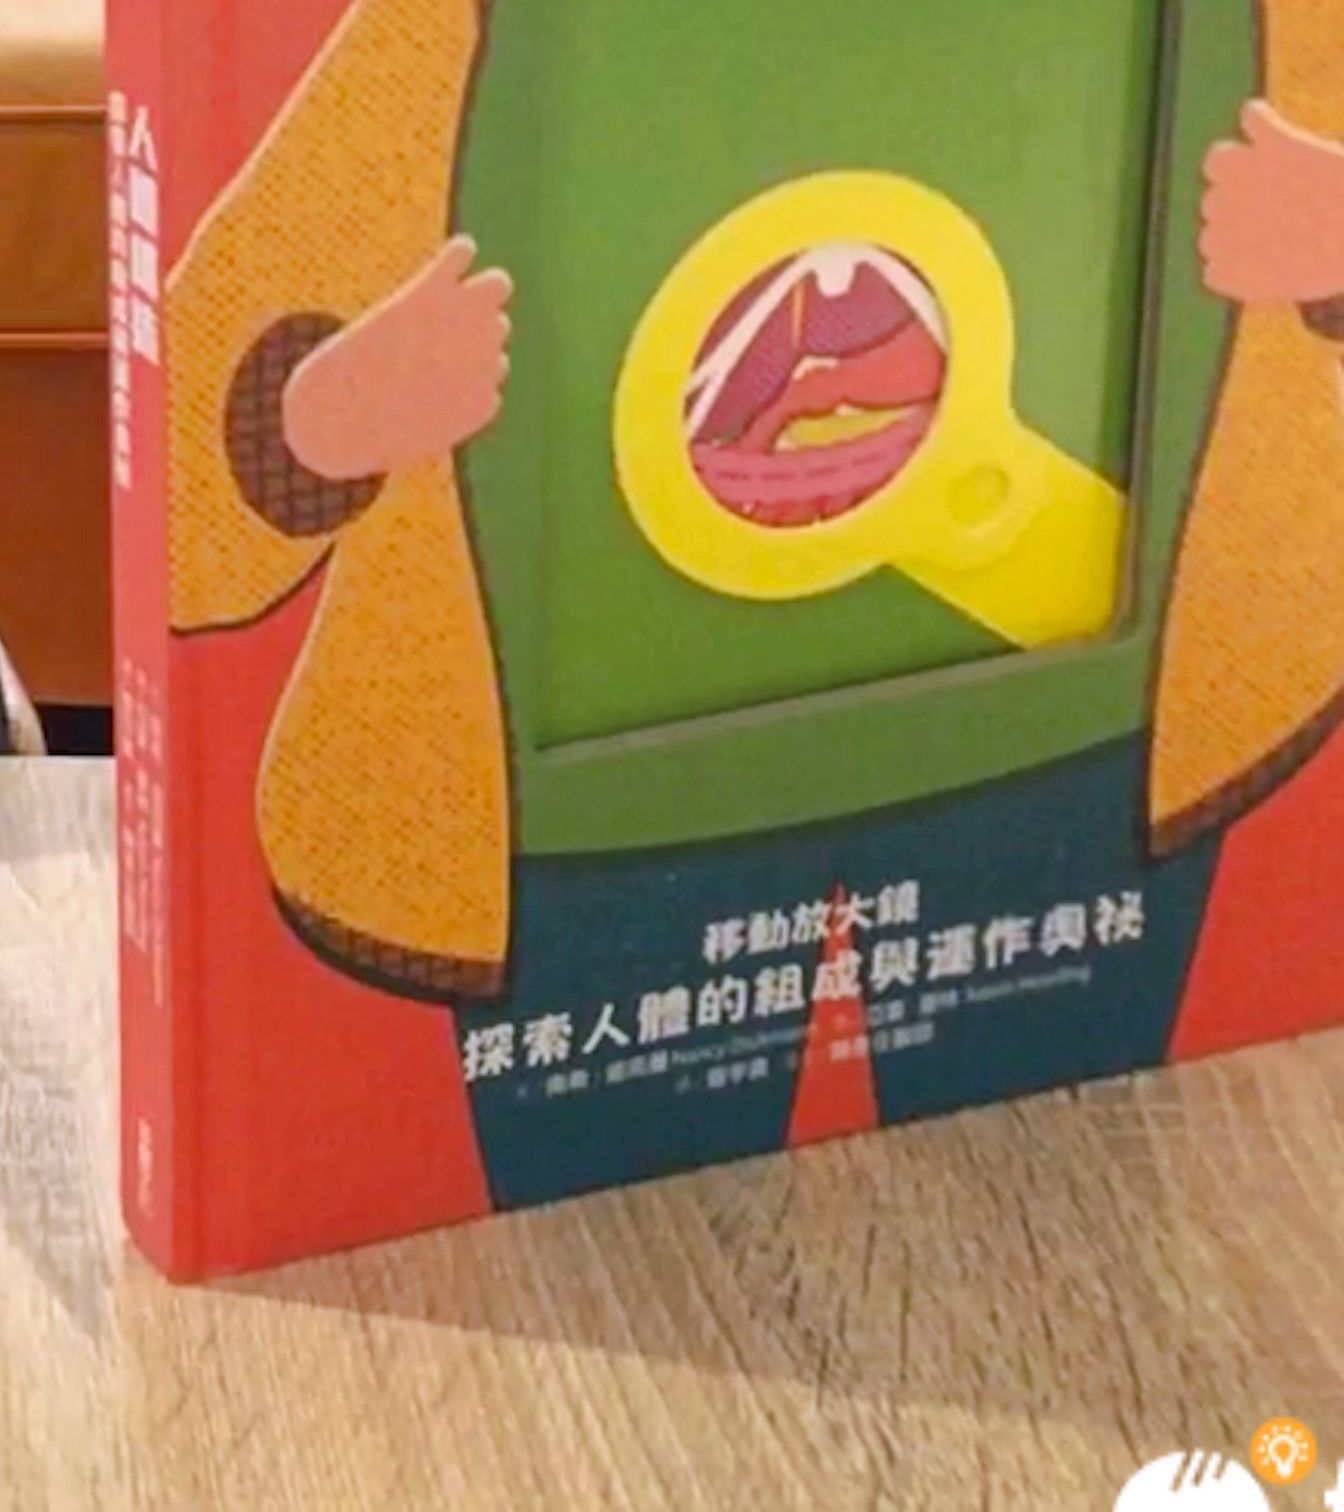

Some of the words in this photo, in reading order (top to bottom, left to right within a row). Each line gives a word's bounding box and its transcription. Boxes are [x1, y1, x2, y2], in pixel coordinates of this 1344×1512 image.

[703, 878, 921, 963] 移動放大鏡
